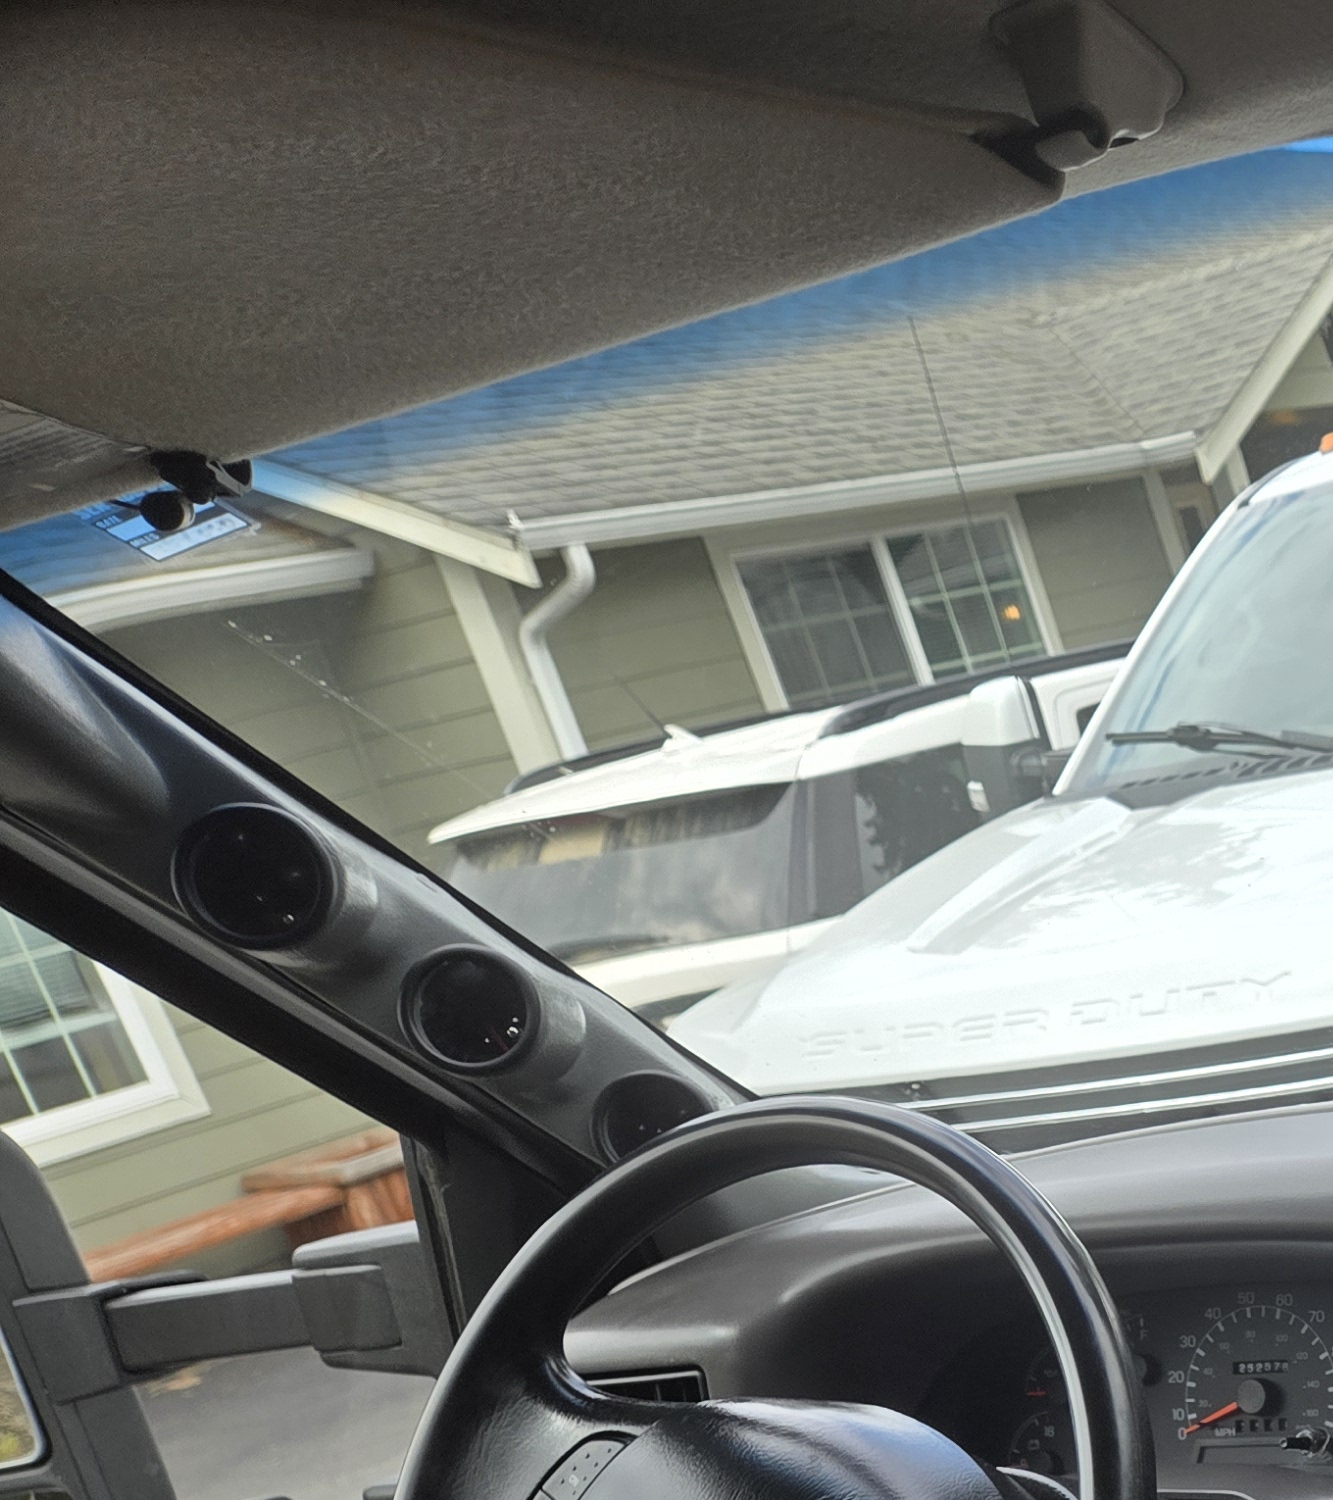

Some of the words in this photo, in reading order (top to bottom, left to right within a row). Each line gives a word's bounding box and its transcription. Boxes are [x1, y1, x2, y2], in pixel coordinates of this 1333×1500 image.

[799, 1008, 1050, 1058] SUPER
[1071, 970, 1293, 1025] DUTY
[1238, 1293, 1255, 1305] 50
[1276, 1294, 1293, 1306] 60
[1204, 1307, 1222, 1320] 40
[1308, 1310, 1325, 1323] 70
[1179, 1335, 1197, 1348] 30
[1168, 1370, 1184, 1383] 20
[1173, 1408, 1185, 1421] 10
[1178, 1427, 1187, 1440] 0
[1215, 1427, 1236, 1437] MPH
